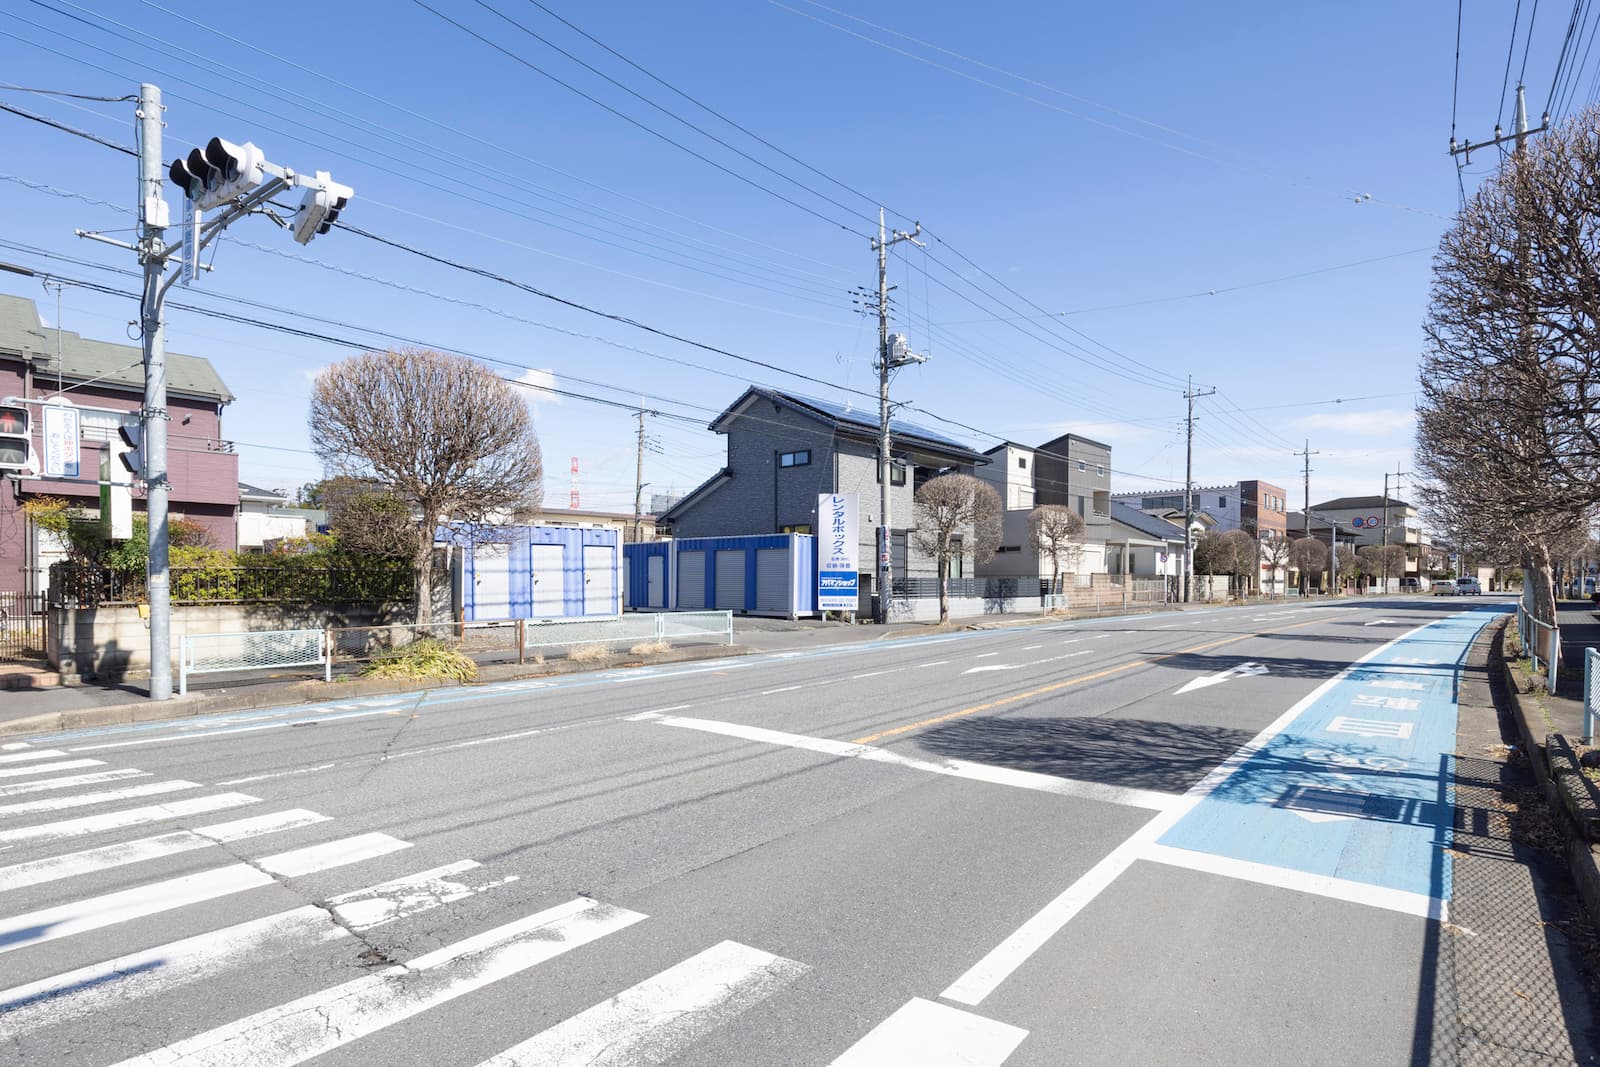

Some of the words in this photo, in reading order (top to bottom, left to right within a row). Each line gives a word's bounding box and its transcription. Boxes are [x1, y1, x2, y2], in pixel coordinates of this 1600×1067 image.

[832, 496, 845, 555] レンタルボックス
